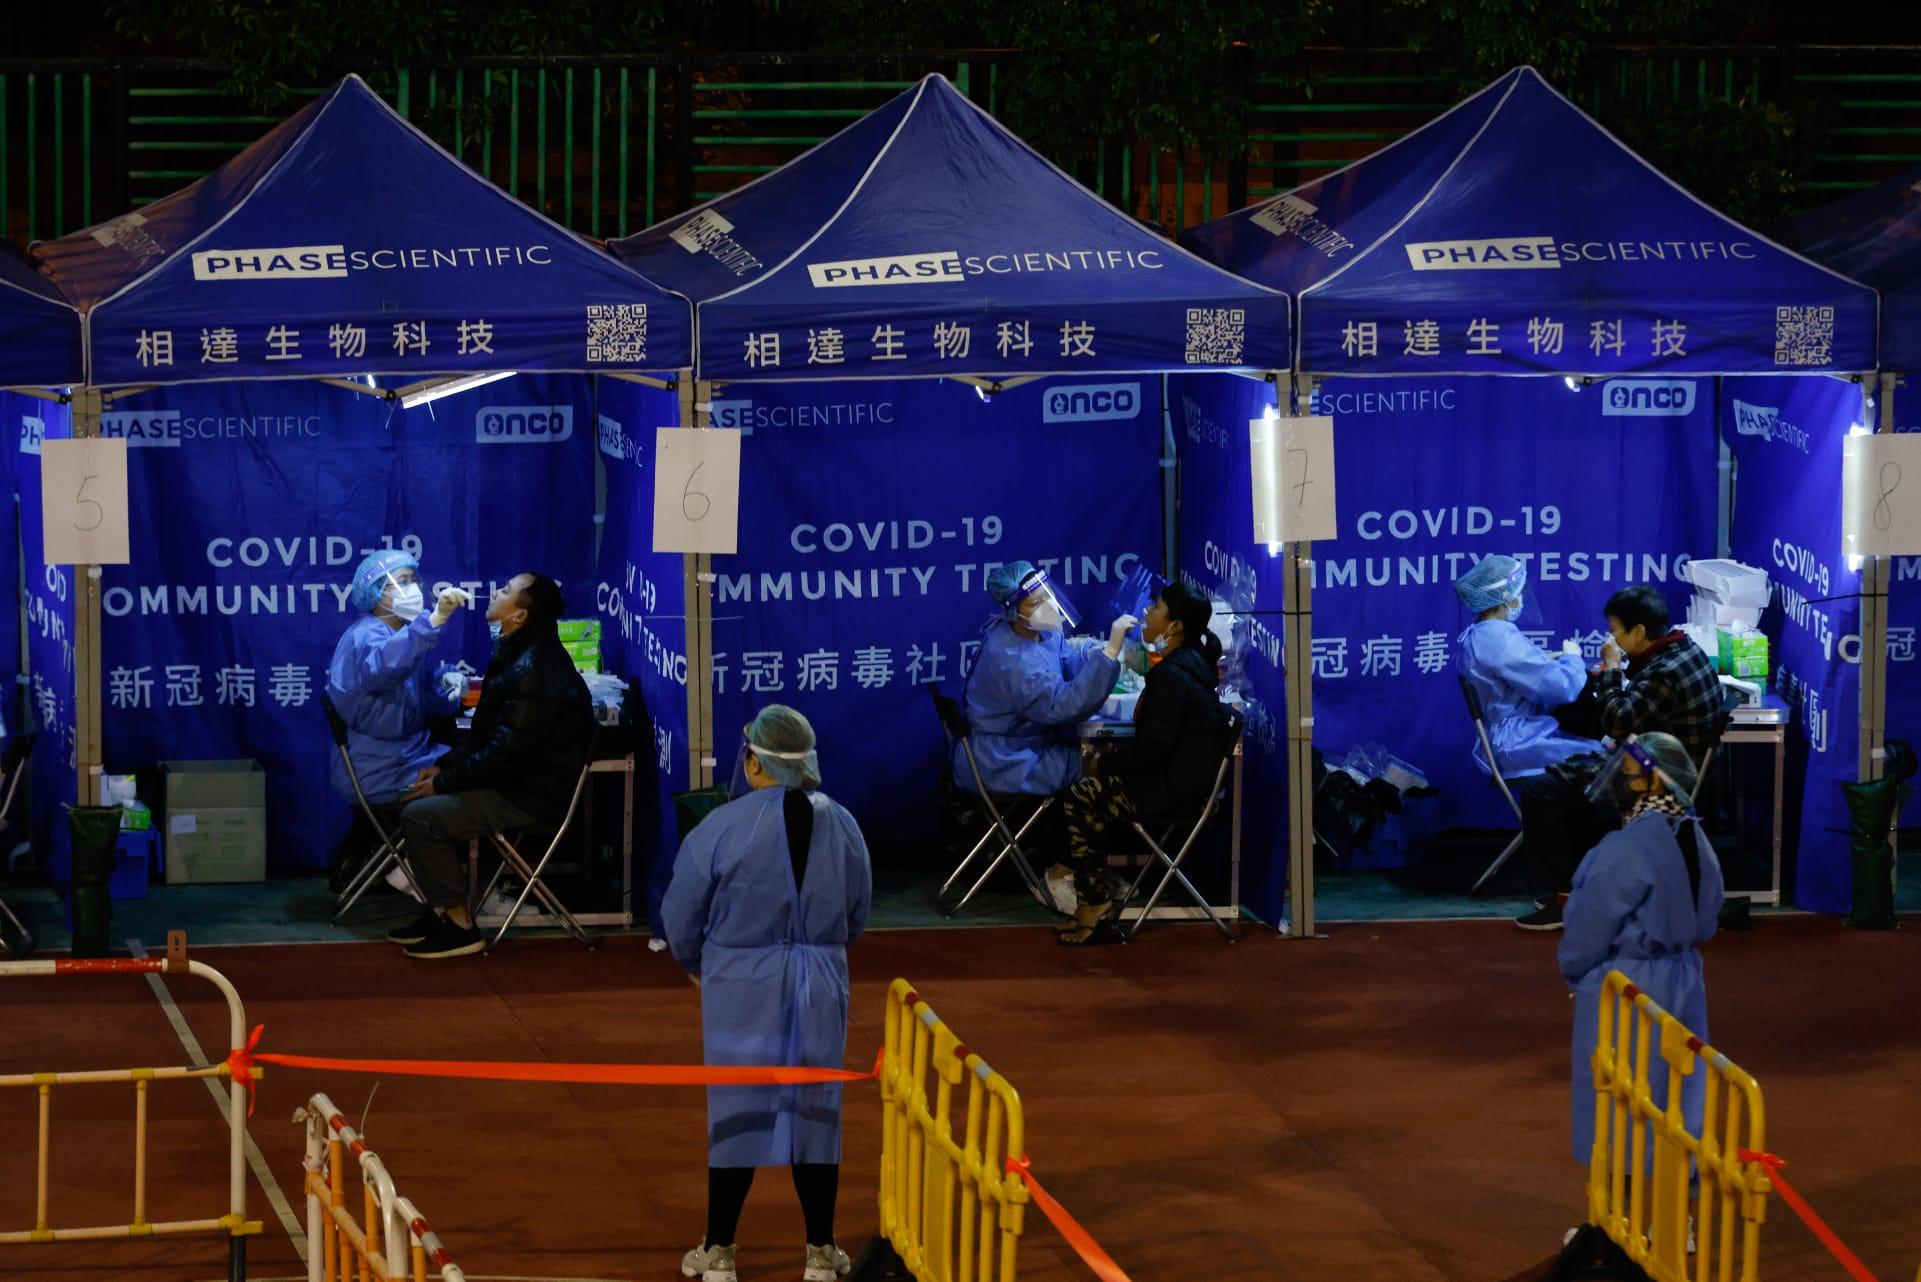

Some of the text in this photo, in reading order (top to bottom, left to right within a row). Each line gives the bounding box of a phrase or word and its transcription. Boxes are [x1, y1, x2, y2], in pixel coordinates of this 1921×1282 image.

[207, 244, 552, 274] PHASE SCIENTIFIC
[825, 250, 1164, 282] PHASE SCIENTIFIC
[1422, 240, 1756, 264] PHASE SCIENTIFIC
[136, 319, 495, 367] 相達生物科技
[743, 320, 1097, 368] 相達生物科技
[1341, 317, 1687, 358] 相達生物科技
[756, 403, 894, 428] SCIENTIFIC
[1323, 389, 1456, 414] SCIENTIFIC
[101, 416, 321, 439] HASE SCIENTIFIC
[682, 462, 711, 521] 6
[1287, 448, 1314, 507] 7
[1873, 461, 1901, 530] 8
[73, 475, 104, 532] 5
[790, 515, 1003, 554] COVID-19
[1357, 506, 1561, 540] COVID-19
[718, 566, 937, 602] MMUNITY
[1773, 538, 1829, 597] COVID-19
[103, 583, 353, 616] OMMUNITY
